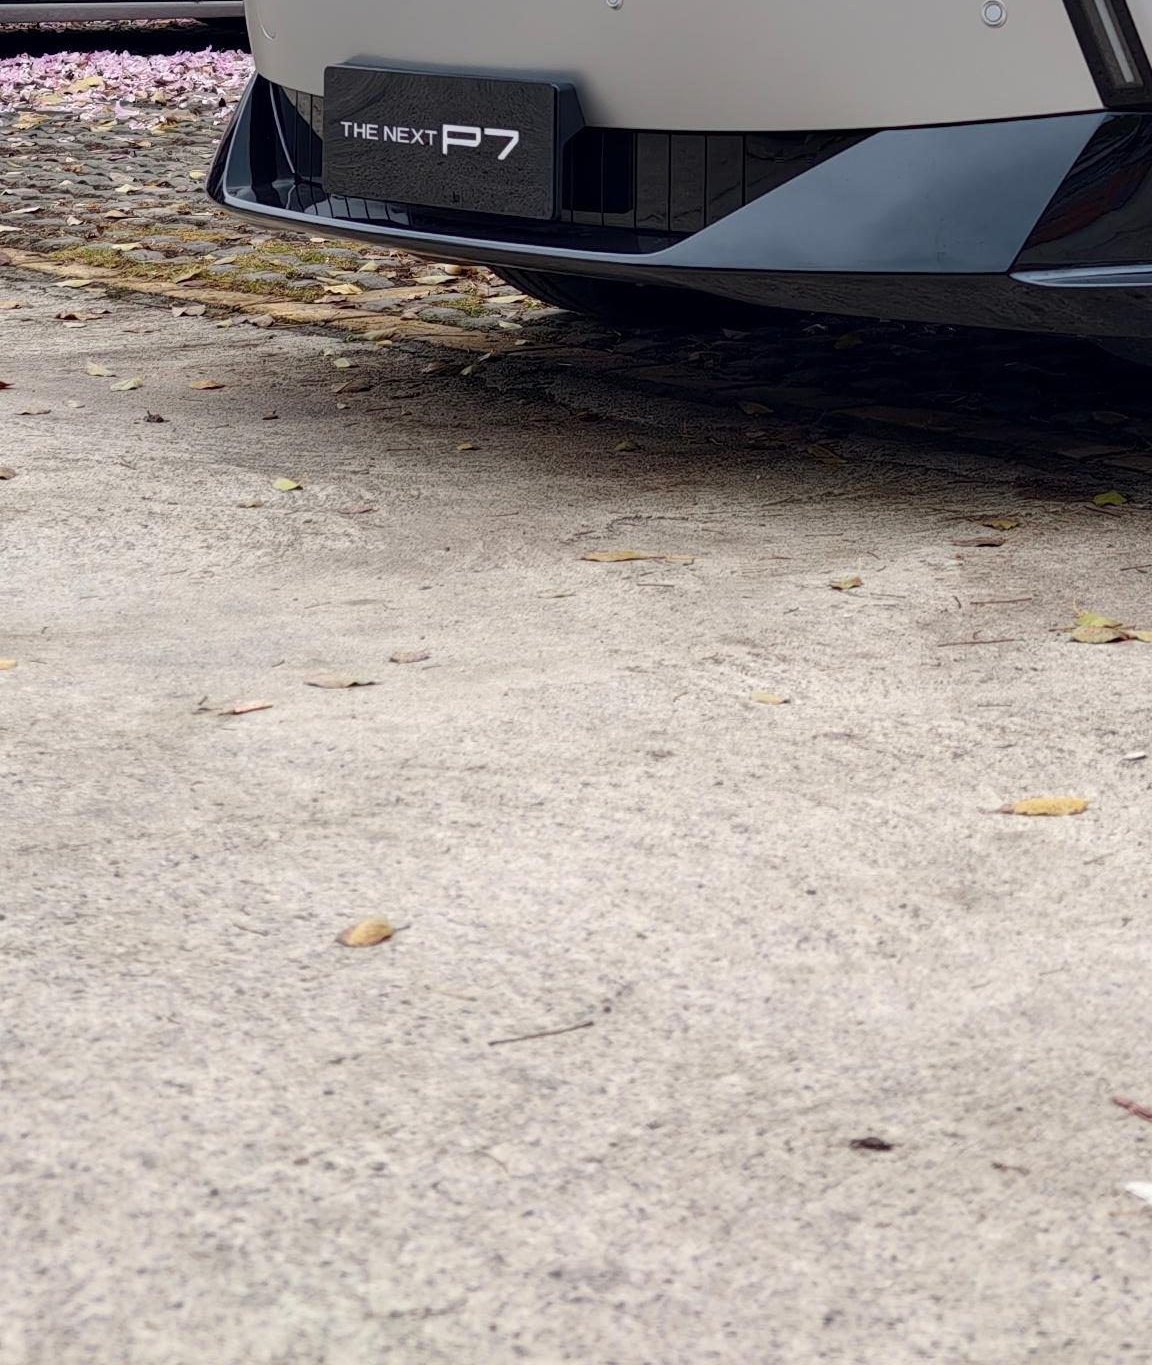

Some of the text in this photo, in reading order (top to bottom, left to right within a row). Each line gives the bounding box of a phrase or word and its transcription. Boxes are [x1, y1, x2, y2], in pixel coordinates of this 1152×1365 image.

[340, 121, 520, 161] THE NEXT P7
